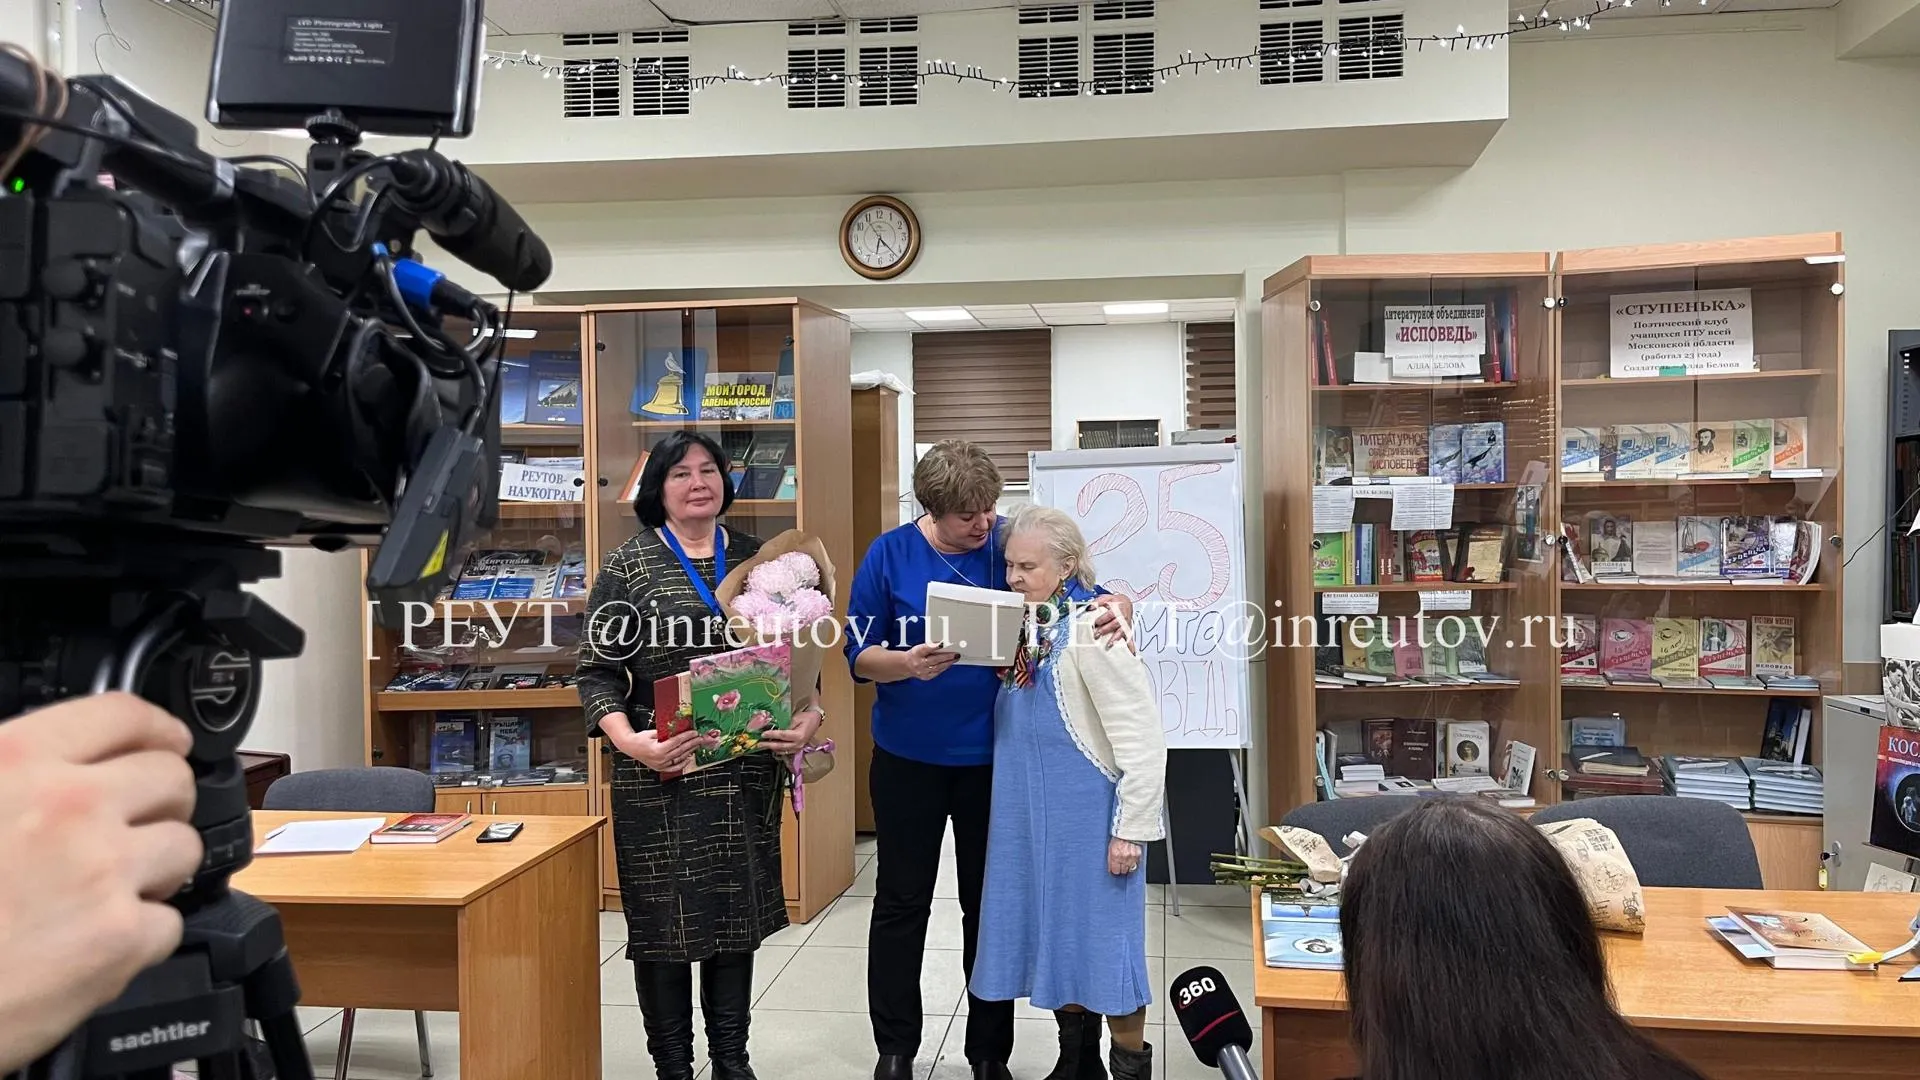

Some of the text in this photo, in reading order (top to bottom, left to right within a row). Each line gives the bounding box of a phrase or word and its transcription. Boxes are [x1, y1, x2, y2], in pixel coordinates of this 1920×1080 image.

[1436, 305, 1485, 321] объединение
[1616, 299, 1746, 316] «СТУПЕНЬКА»
[1633, 317, 1729, 329] Поэтический клуб
[1395, 325, 1478, 344] «ИСПОВЕДЬ»
[1630, 332, 1681, 341] учащихся
[1683, 329, 1705, 337] ПТУ
[1628, 339, 1735, 350] Московской области
[1641, 352, 1682, 361] (работал
[1407, 361, 1466, 370] АЛЛА БЕЛОВА
[1706, 362, 1740, 370] Белова
[706, 383, 767, 397] МОЙ ГОРОД
[740, 397, 772, 407] РОССИИ
[1360, 433, 1427, 446] ЛИТЕРАТУРНОЕ
[521, 470, 568, 484] РЕУТОВ-
[1077, 463, 1231, 612] 25
[1180, 977, 1217, 1005] 360
[110, 1020, 211, 1053] sachtler
